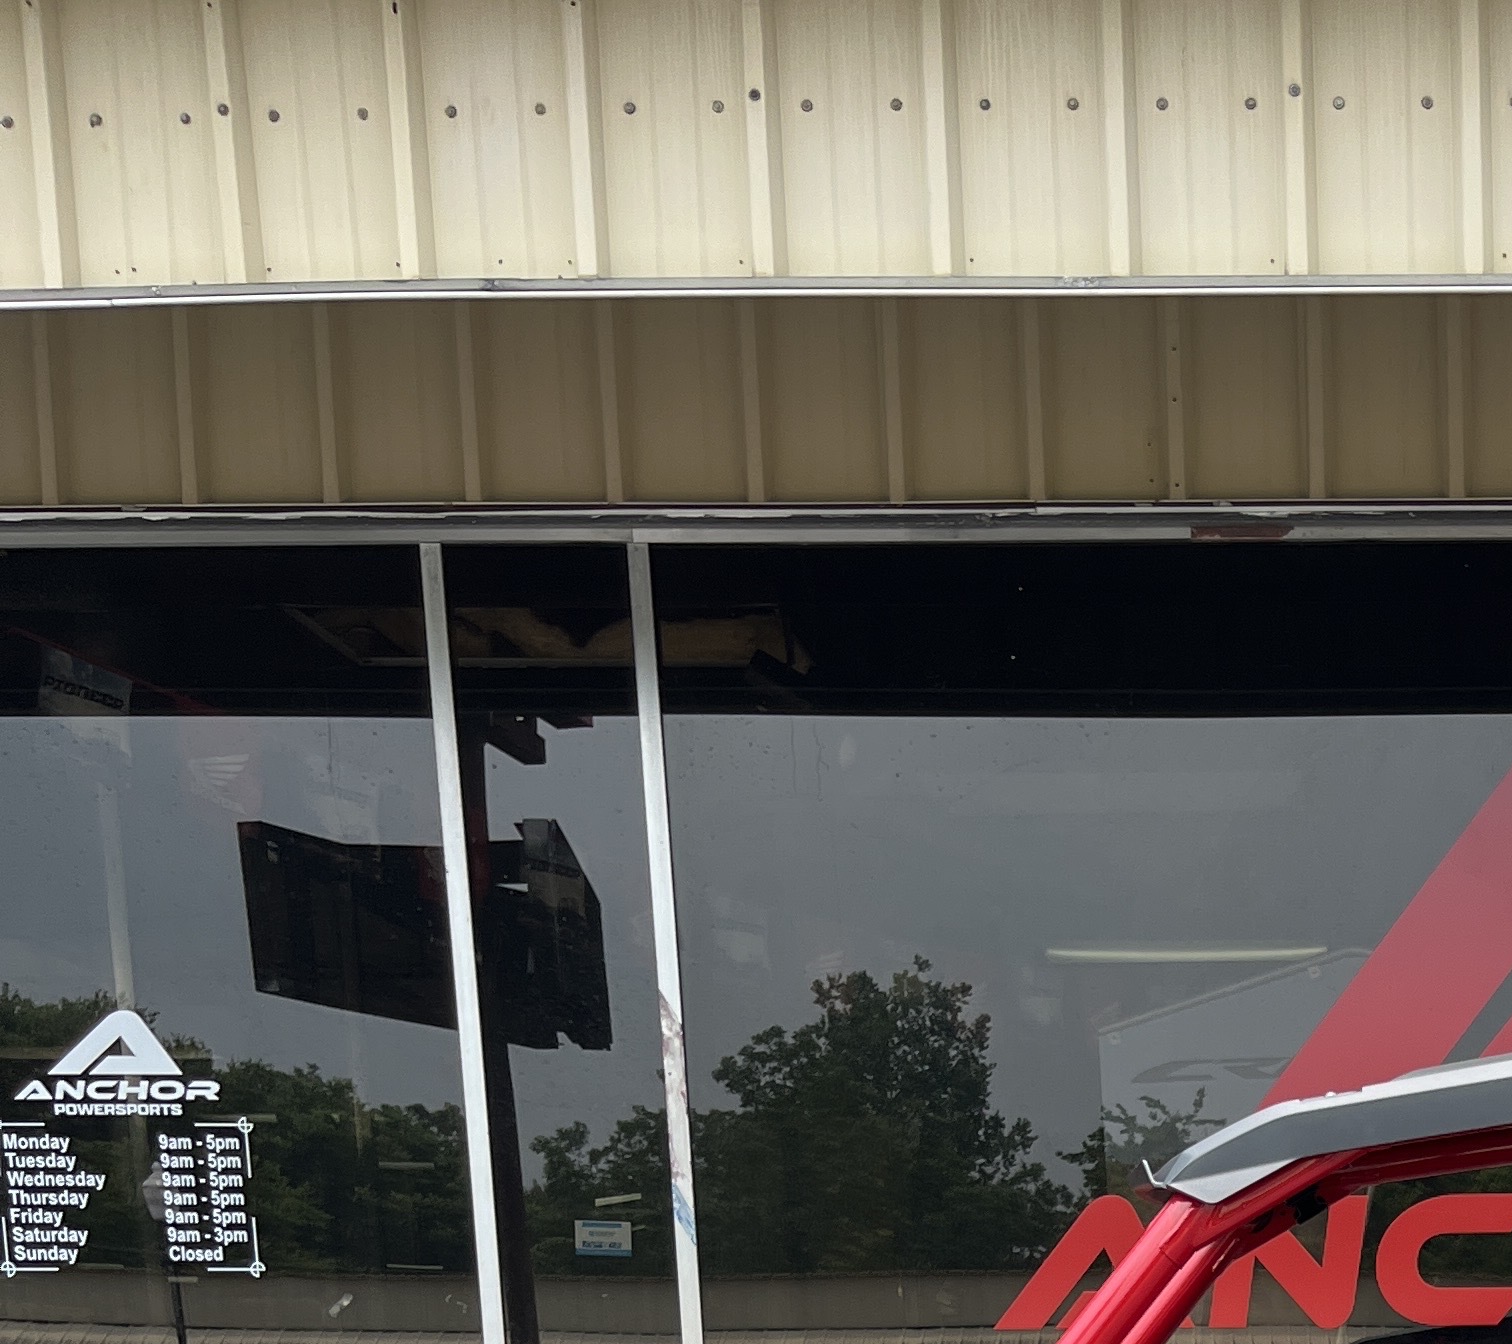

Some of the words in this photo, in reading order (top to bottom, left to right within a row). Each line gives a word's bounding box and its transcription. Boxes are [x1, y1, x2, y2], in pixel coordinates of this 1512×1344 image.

[14, 1080, 221, 1101] ANCHOR
[54, 1104, 184, 1116] POWERSPORTS
[2, 1134, 70, 1152] Monday
[159, 1135, 192, 1150] 9am
[206, 1135, 240, 1153] 5pm
[5, 1152, 76, 1171] Tuesday
[160, 1153, 194, 1169] 9am
[207, 1153, 242, 1172] 5pm
[6, 1171, 106, 1190] Wednesday
[162, 1172, 196, 1187] 9am
[209, 1172, 243, 1190] 5pm
[8, 1189, 89, 1209] Thursday
[163, 1190, 197, 1206] 9am
[210, 1190, 245, 1209] 5pm
[10, 1208, 64, 1228] Friday
[165, 1209, 199, 1224] 9am
[212, 1209, 246, 1228] 5pm
[12, 1227, 88, 1246] Saturday
[167, 1228, 201, 1243] 9am
[214, 1228, 248, 1247] 3pm
[14, 1245, 78, 1265] Sunday
[169, 1246, 224, 1262] Closed
